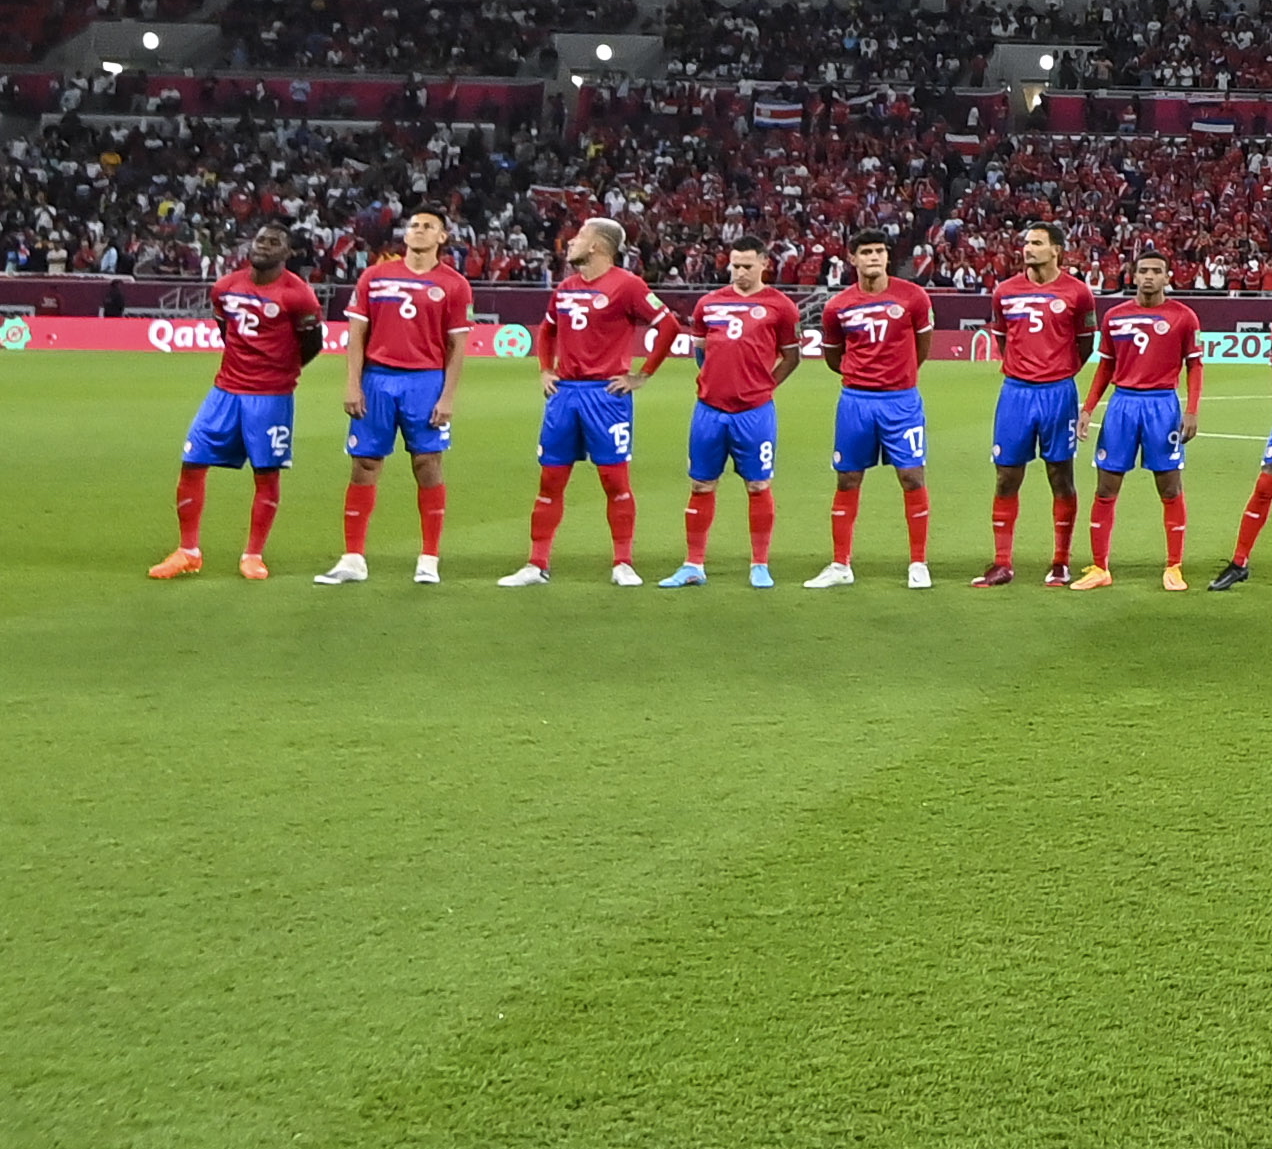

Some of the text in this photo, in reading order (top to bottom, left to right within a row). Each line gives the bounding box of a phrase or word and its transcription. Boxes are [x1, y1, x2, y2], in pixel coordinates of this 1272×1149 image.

[399, 294, 417, 319] 6
[235, 312, 260, 336] 12
[726, 318, 743, 339] 8
[864, 317, 888, 342] 17
[1029, 310, 1043, 332] 5
[1133, 332, 1149, 354] 9
[266, 425, 290, 448] 12
[608, 422, 630, 446] 15
[903, 426, 923, 451] 17
[1068, 419, 1075, 441] 5
[760, 441, 773, 462] 8
[1168, 431, 1179, 452] 9
